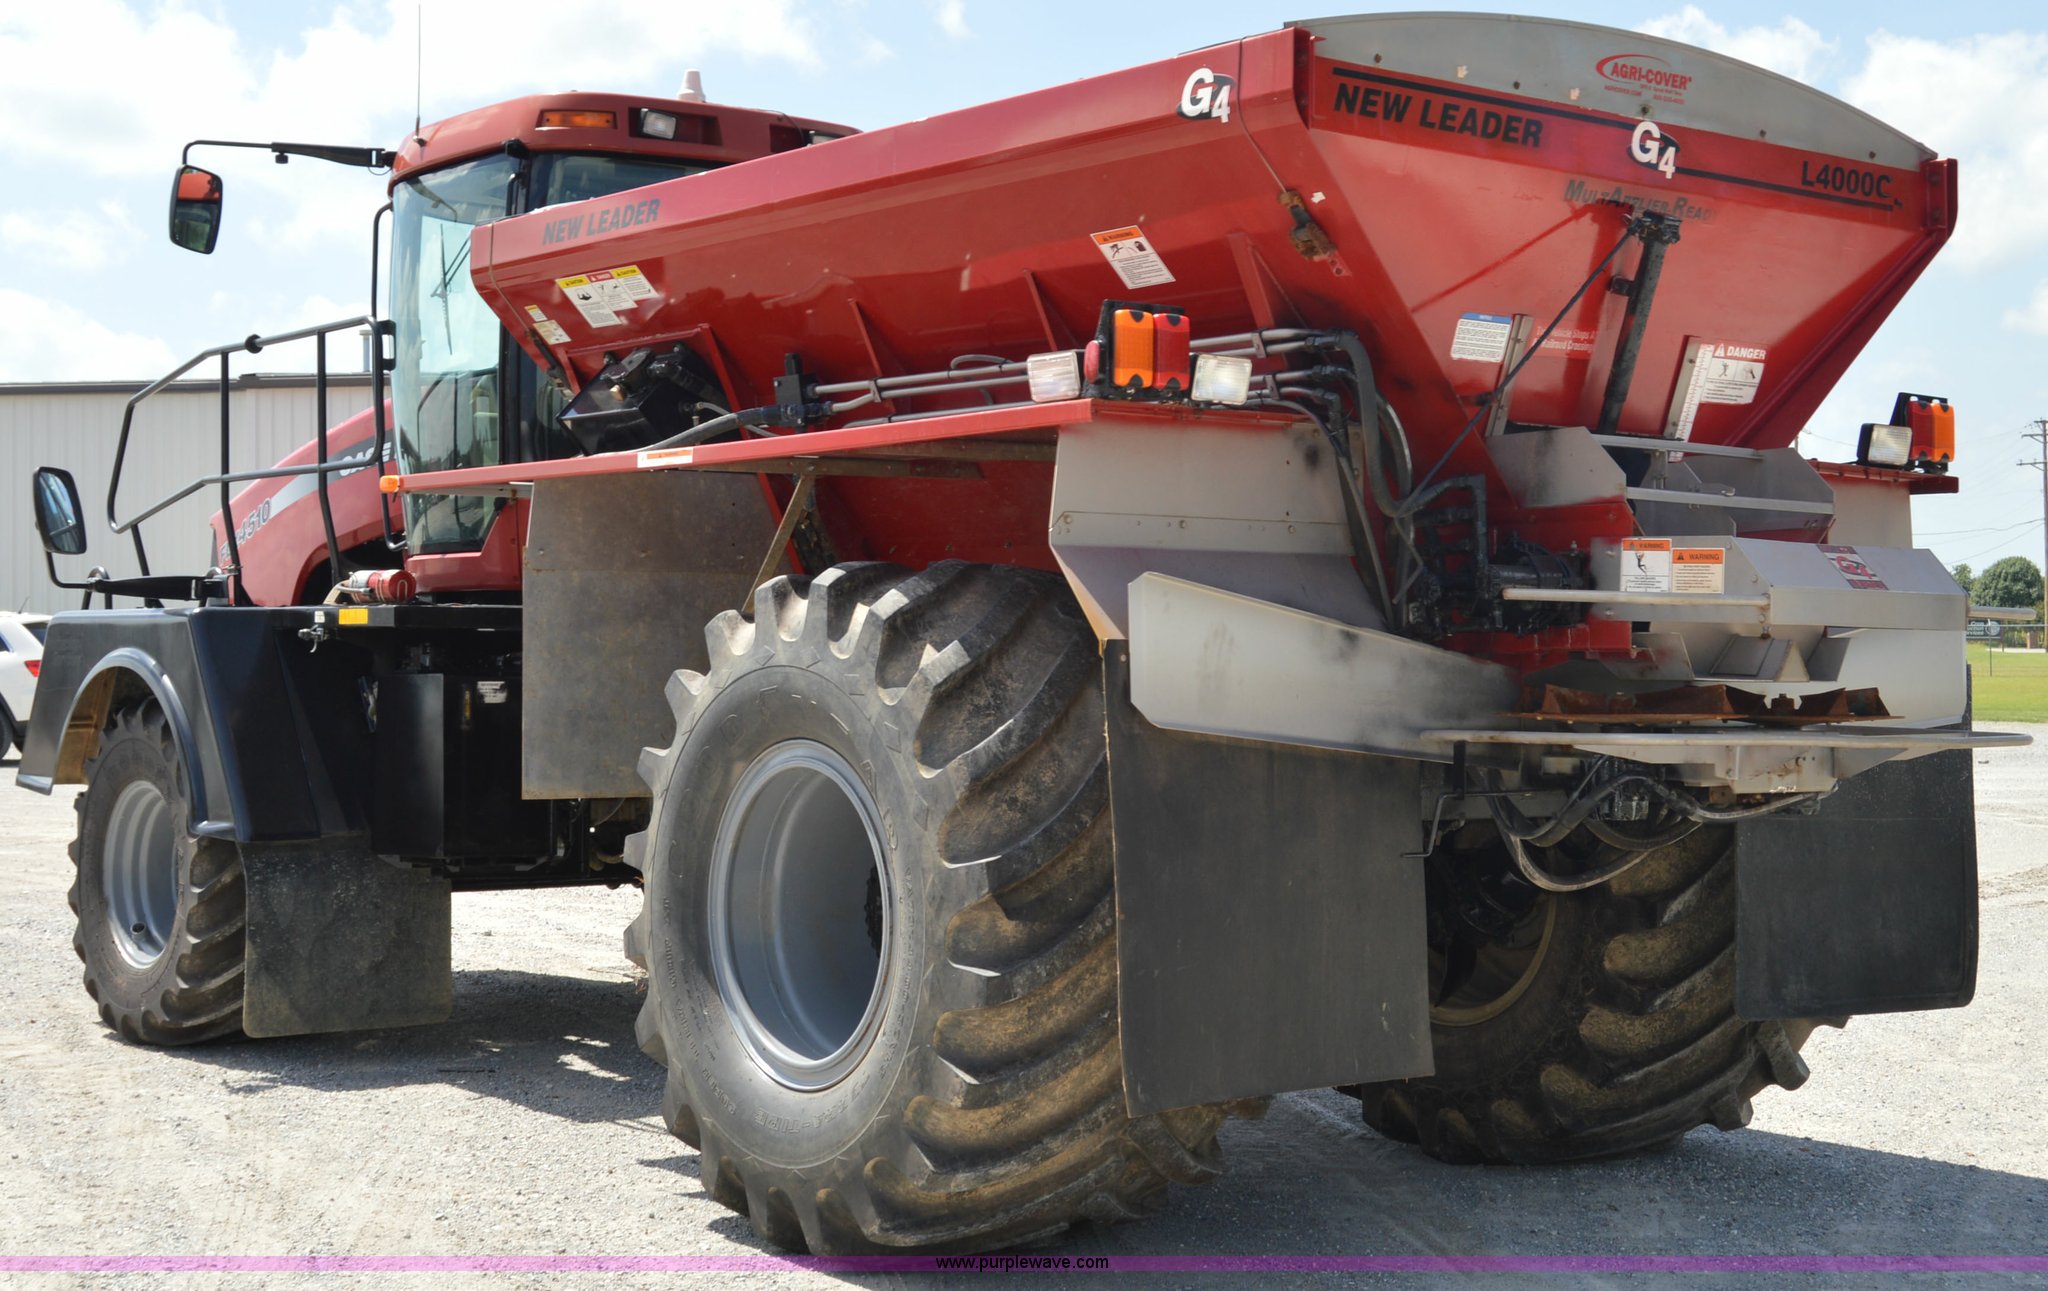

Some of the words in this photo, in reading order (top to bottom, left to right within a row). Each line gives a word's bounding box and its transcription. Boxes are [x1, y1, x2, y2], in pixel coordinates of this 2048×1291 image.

[1181, 67, 1231, 124] G4
[1334, 82, 1413, 122] NEW
[1419, 98, 1543, 148] LEADER
[1631, 121, 1676, 179] G4
[1801, 160, 1893, 199] L4000C
[543, 215, 583, 246] NEW
[586, 198, 661, 237] LEADER
[1726, 346, 1766, 360] DANGER
[1689, 553, 1720, 561] WARNING
